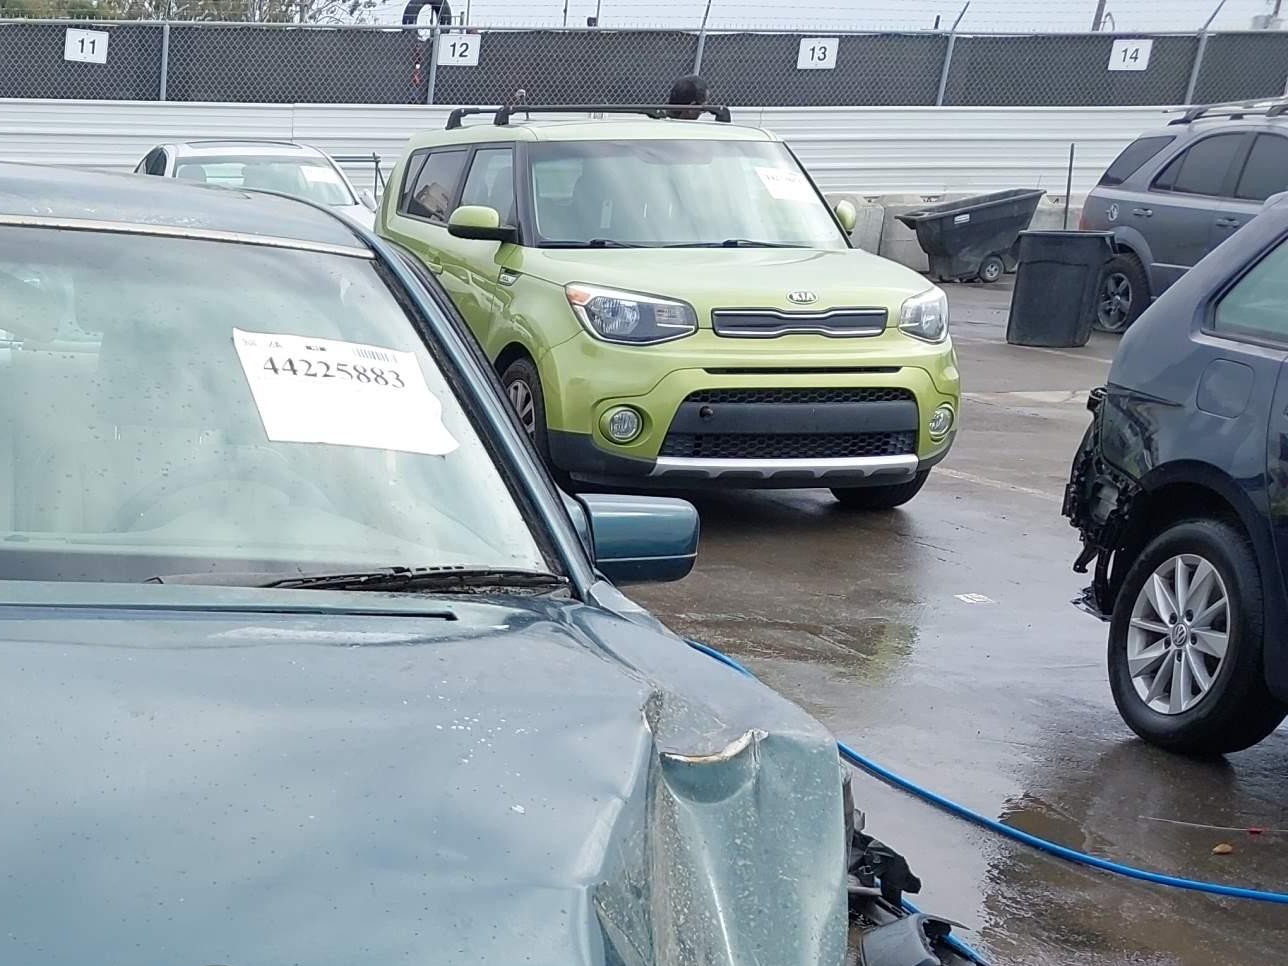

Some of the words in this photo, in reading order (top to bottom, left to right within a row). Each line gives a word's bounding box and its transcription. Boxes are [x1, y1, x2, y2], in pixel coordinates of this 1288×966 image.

[78, 37, 96, 55] 11
[449, 41, 469, 58] 12
[809, 45, 827, 62] 13
[1121, 47, 1140, 63] 14
[791, 291, 815, 302] KIA
[263, 355, 405, 389] 44225883
